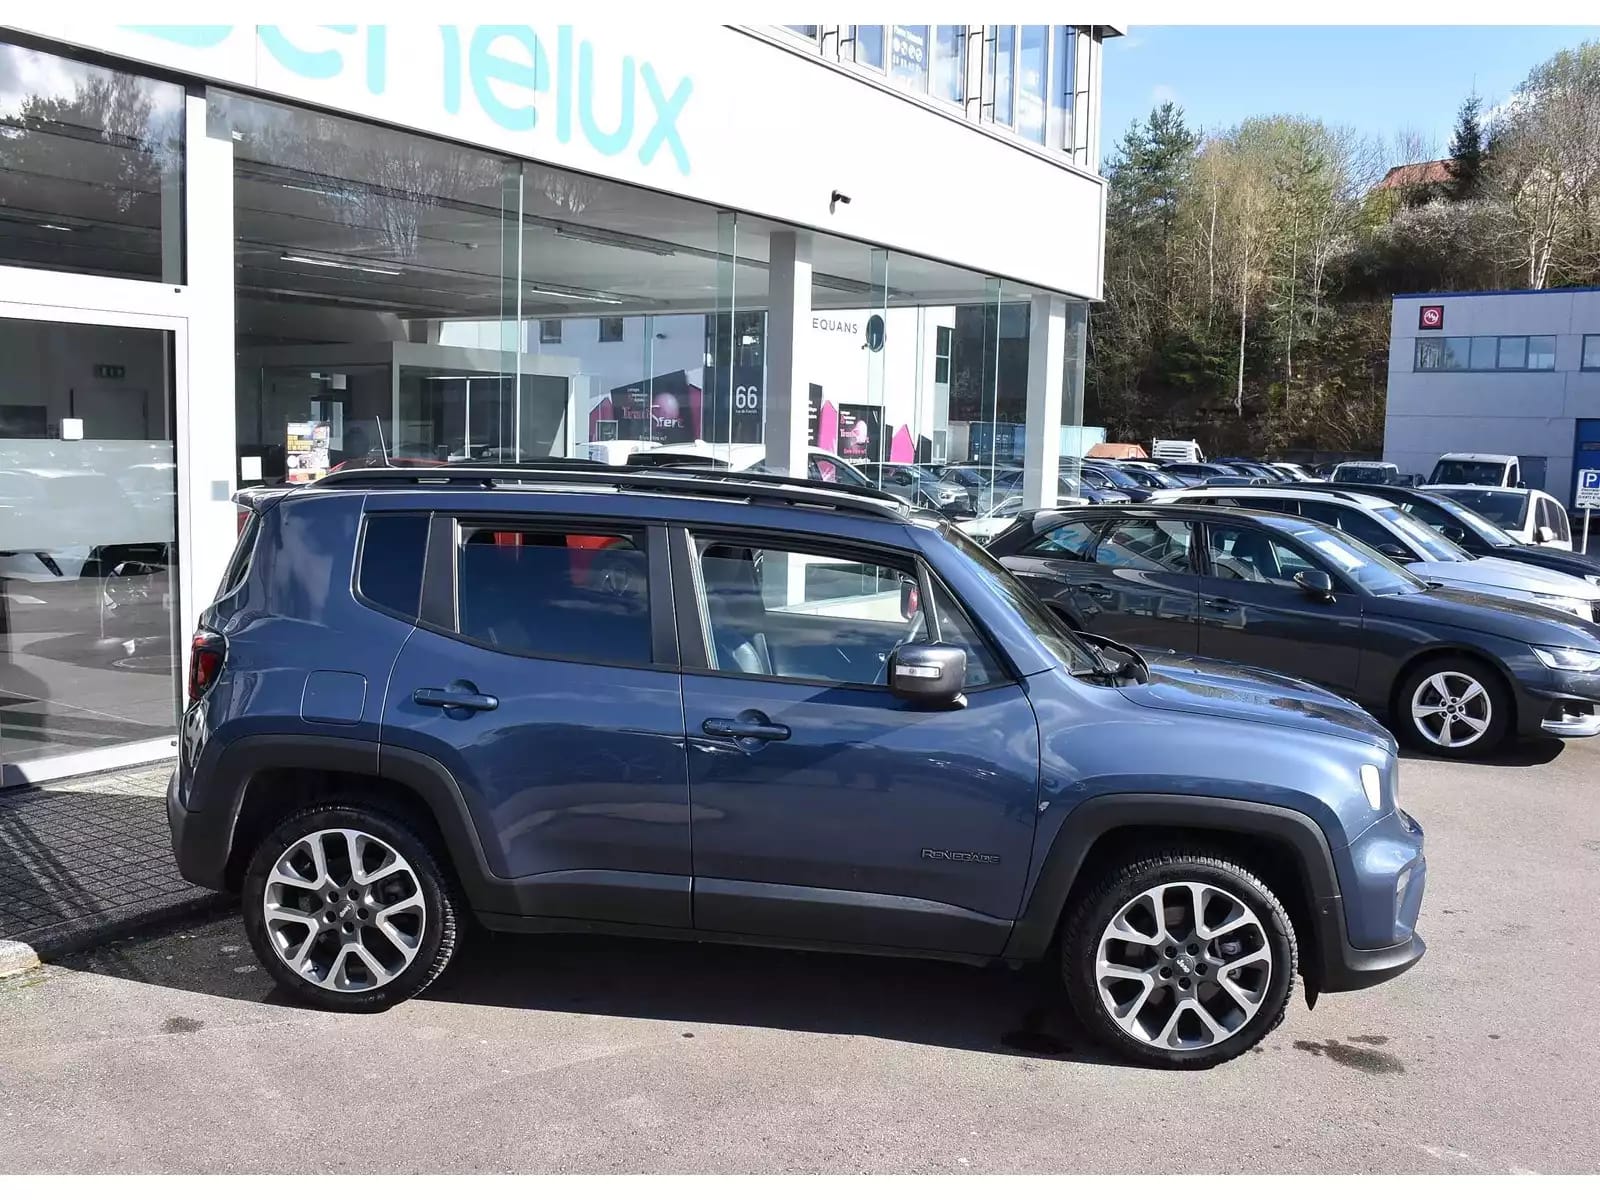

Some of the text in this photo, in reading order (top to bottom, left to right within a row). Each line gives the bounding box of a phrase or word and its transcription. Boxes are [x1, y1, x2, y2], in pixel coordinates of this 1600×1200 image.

[812, 317, 858, 335] EQUANS
[735, 385, 758, 409] 66
[1585, 473, 1598, 488] P
